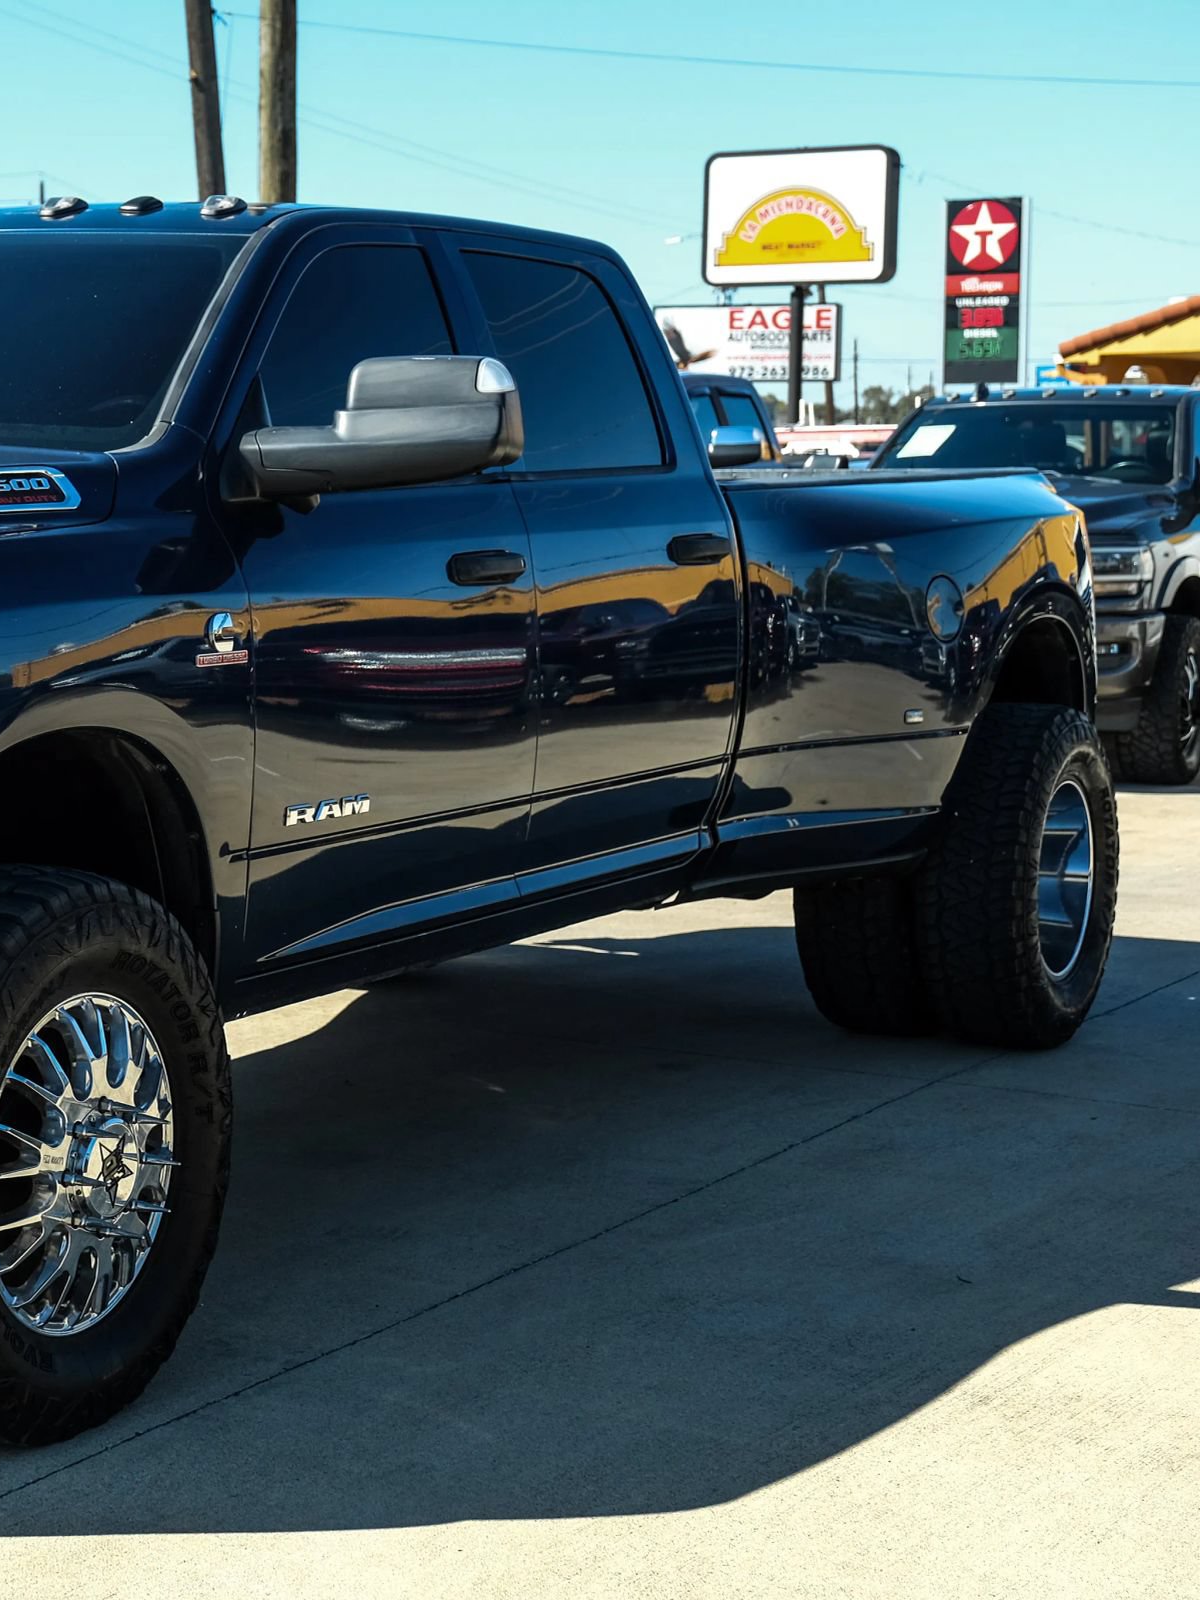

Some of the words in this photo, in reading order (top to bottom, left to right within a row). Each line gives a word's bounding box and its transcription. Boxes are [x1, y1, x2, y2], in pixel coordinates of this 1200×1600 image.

[955, 296, 1010, 308] UNLEADED
[963, 328, 998, 339] DIESEL
[24, 494, 57, 503] DUTY
[283, 793, 370, 827] RAM
